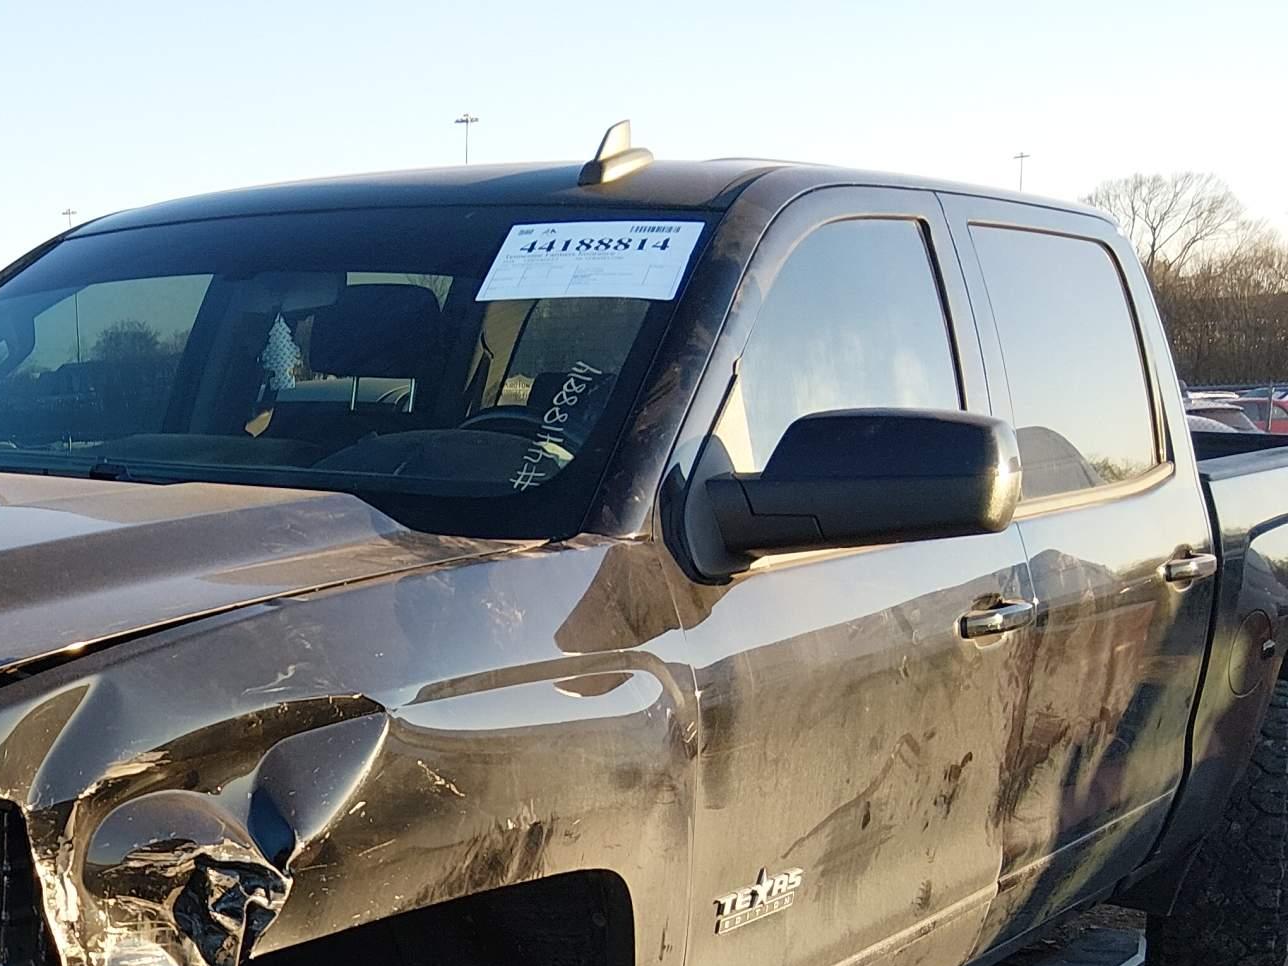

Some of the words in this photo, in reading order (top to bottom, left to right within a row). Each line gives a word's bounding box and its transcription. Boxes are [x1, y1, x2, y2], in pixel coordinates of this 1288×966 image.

[519, 236, 672, 254] 44188814
[713, 865, 805, 917] TEXAS
[723, 894, 792, 930] EDITION
